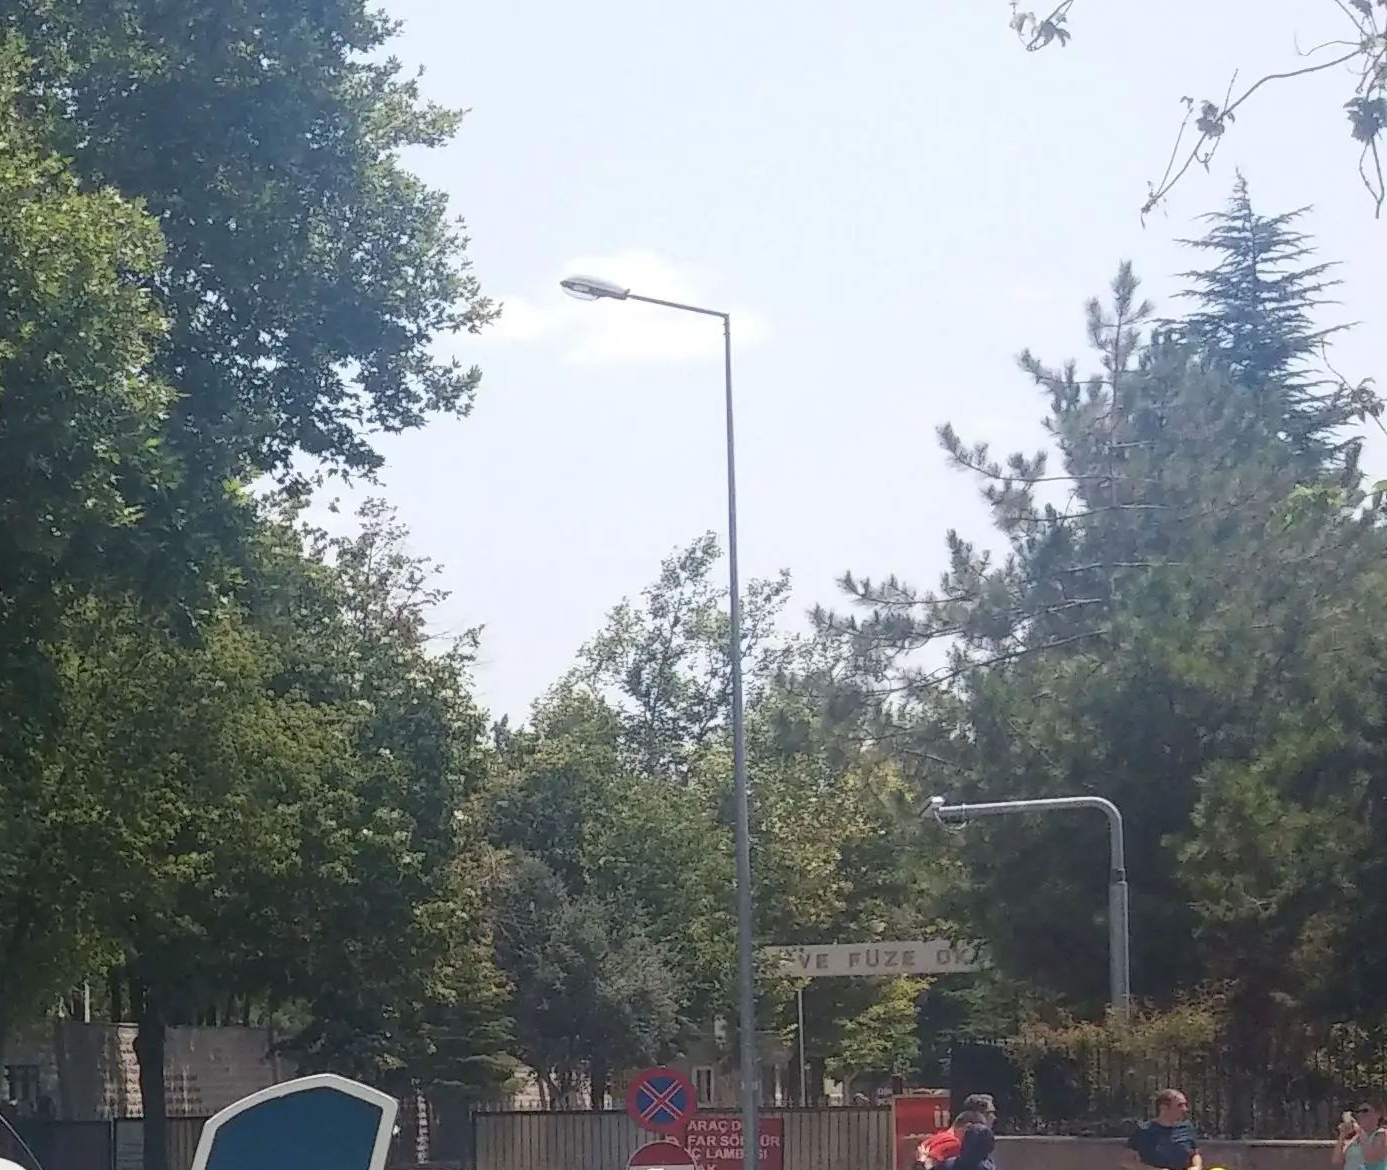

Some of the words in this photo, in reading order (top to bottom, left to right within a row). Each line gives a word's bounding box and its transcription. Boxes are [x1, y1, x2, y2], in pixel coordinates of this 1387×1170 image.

[798, 953, 828, 969] VE
[849, 949, 915, 967] FÜZE
[687, 1120, 728, 1133] ARAÇ
[687, 1135, 717, 1146] FAR
[720, 1133, 780, 1147] SÖÜR
[706, 1148, 768, 1159] LAMBSI
